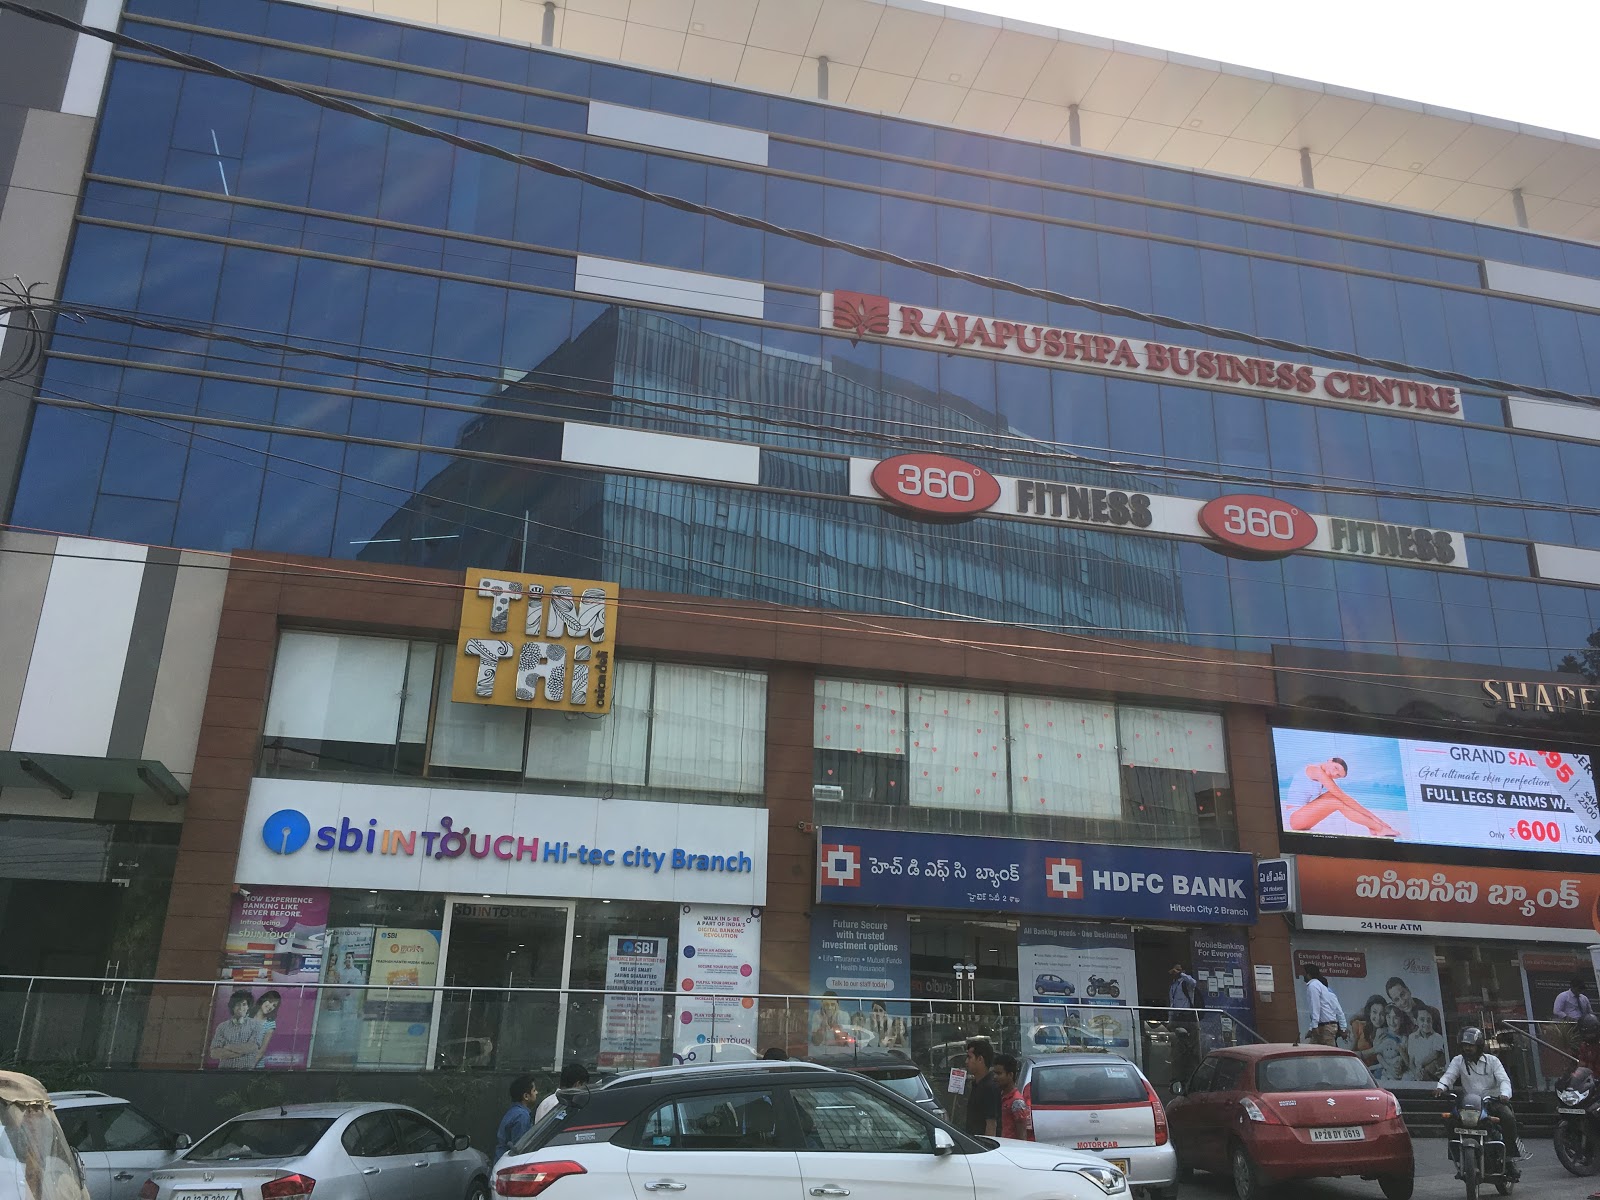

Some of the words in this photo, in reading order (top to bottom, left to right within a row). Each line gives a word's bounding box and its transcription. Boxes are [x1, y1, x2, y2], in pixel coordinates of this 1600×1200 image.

[899, 306, 1140, 369] RAJAPUSHPA
[1144, 342, 1316, 393] BUSINESS
[1323, 371, 1460, 414] CENTRE
[1015, 479, 1153, 528] FITNESS
[1329, 517, 1456, 564] FITNESS
[1450, 747, 1506, 764] GRAND
[1508, 751, 1539, 767] SAL
[1418, 766, 1438, 779] Get
[1441, 768, 1480, 781] ultimate
[1482, 771, 1501, 784] skin
[1503, 774, 1550, 790] perfection
[1426, 787, 1459, 801] FULL
[1461, 790, 1494, 804] LEGS
[1497, 793, 1506, 804] &
[1510, 794, 1547, 808] ARMS
[1489, 830, 1504, 840] Only
[543, 841, 615, 865] Hi-tec
[622, 845, 666, 874] city
[671, 848, 752, 873] Branch
[1092, 870, 1164, 894] HDFC
[1172, 874, 1247, 899] BANK
[265, 896, 313, 904] EXPERIENCE
[1488, 879, 1581, 917] బ్యాంక్
[1169, 903, 1195, 913] Hitech
[1197, 905, 1212, 915] City
[1214, 906, 1220, 914] 2
[1221, 907, 1249, 917] Branch
[832, 919, 859, 929] Future
[860, 920, 888, 930] Secure
[1360, 921, 1373, 930] 24
[1374, 922, 1398, 931] Hour
[1400, 923, 1422, 932] ATM
[836, 930, 854, 939] with
[856, 931, 885, 940] trusted
[1033, 928, 1057, 937] Banking
[1058, 929, 1076, 937] needs
[1094, 931, 1128, 940] Destination
[634, 942, 654, 954] SBI
[822, 940, 867, 950] investment
[869, 942, 898, 952] options
[1211, 949, 1242, 958] Everyone
[859, 965, 885, 973] Insurance
[1329, 967, 1349, 975] family
